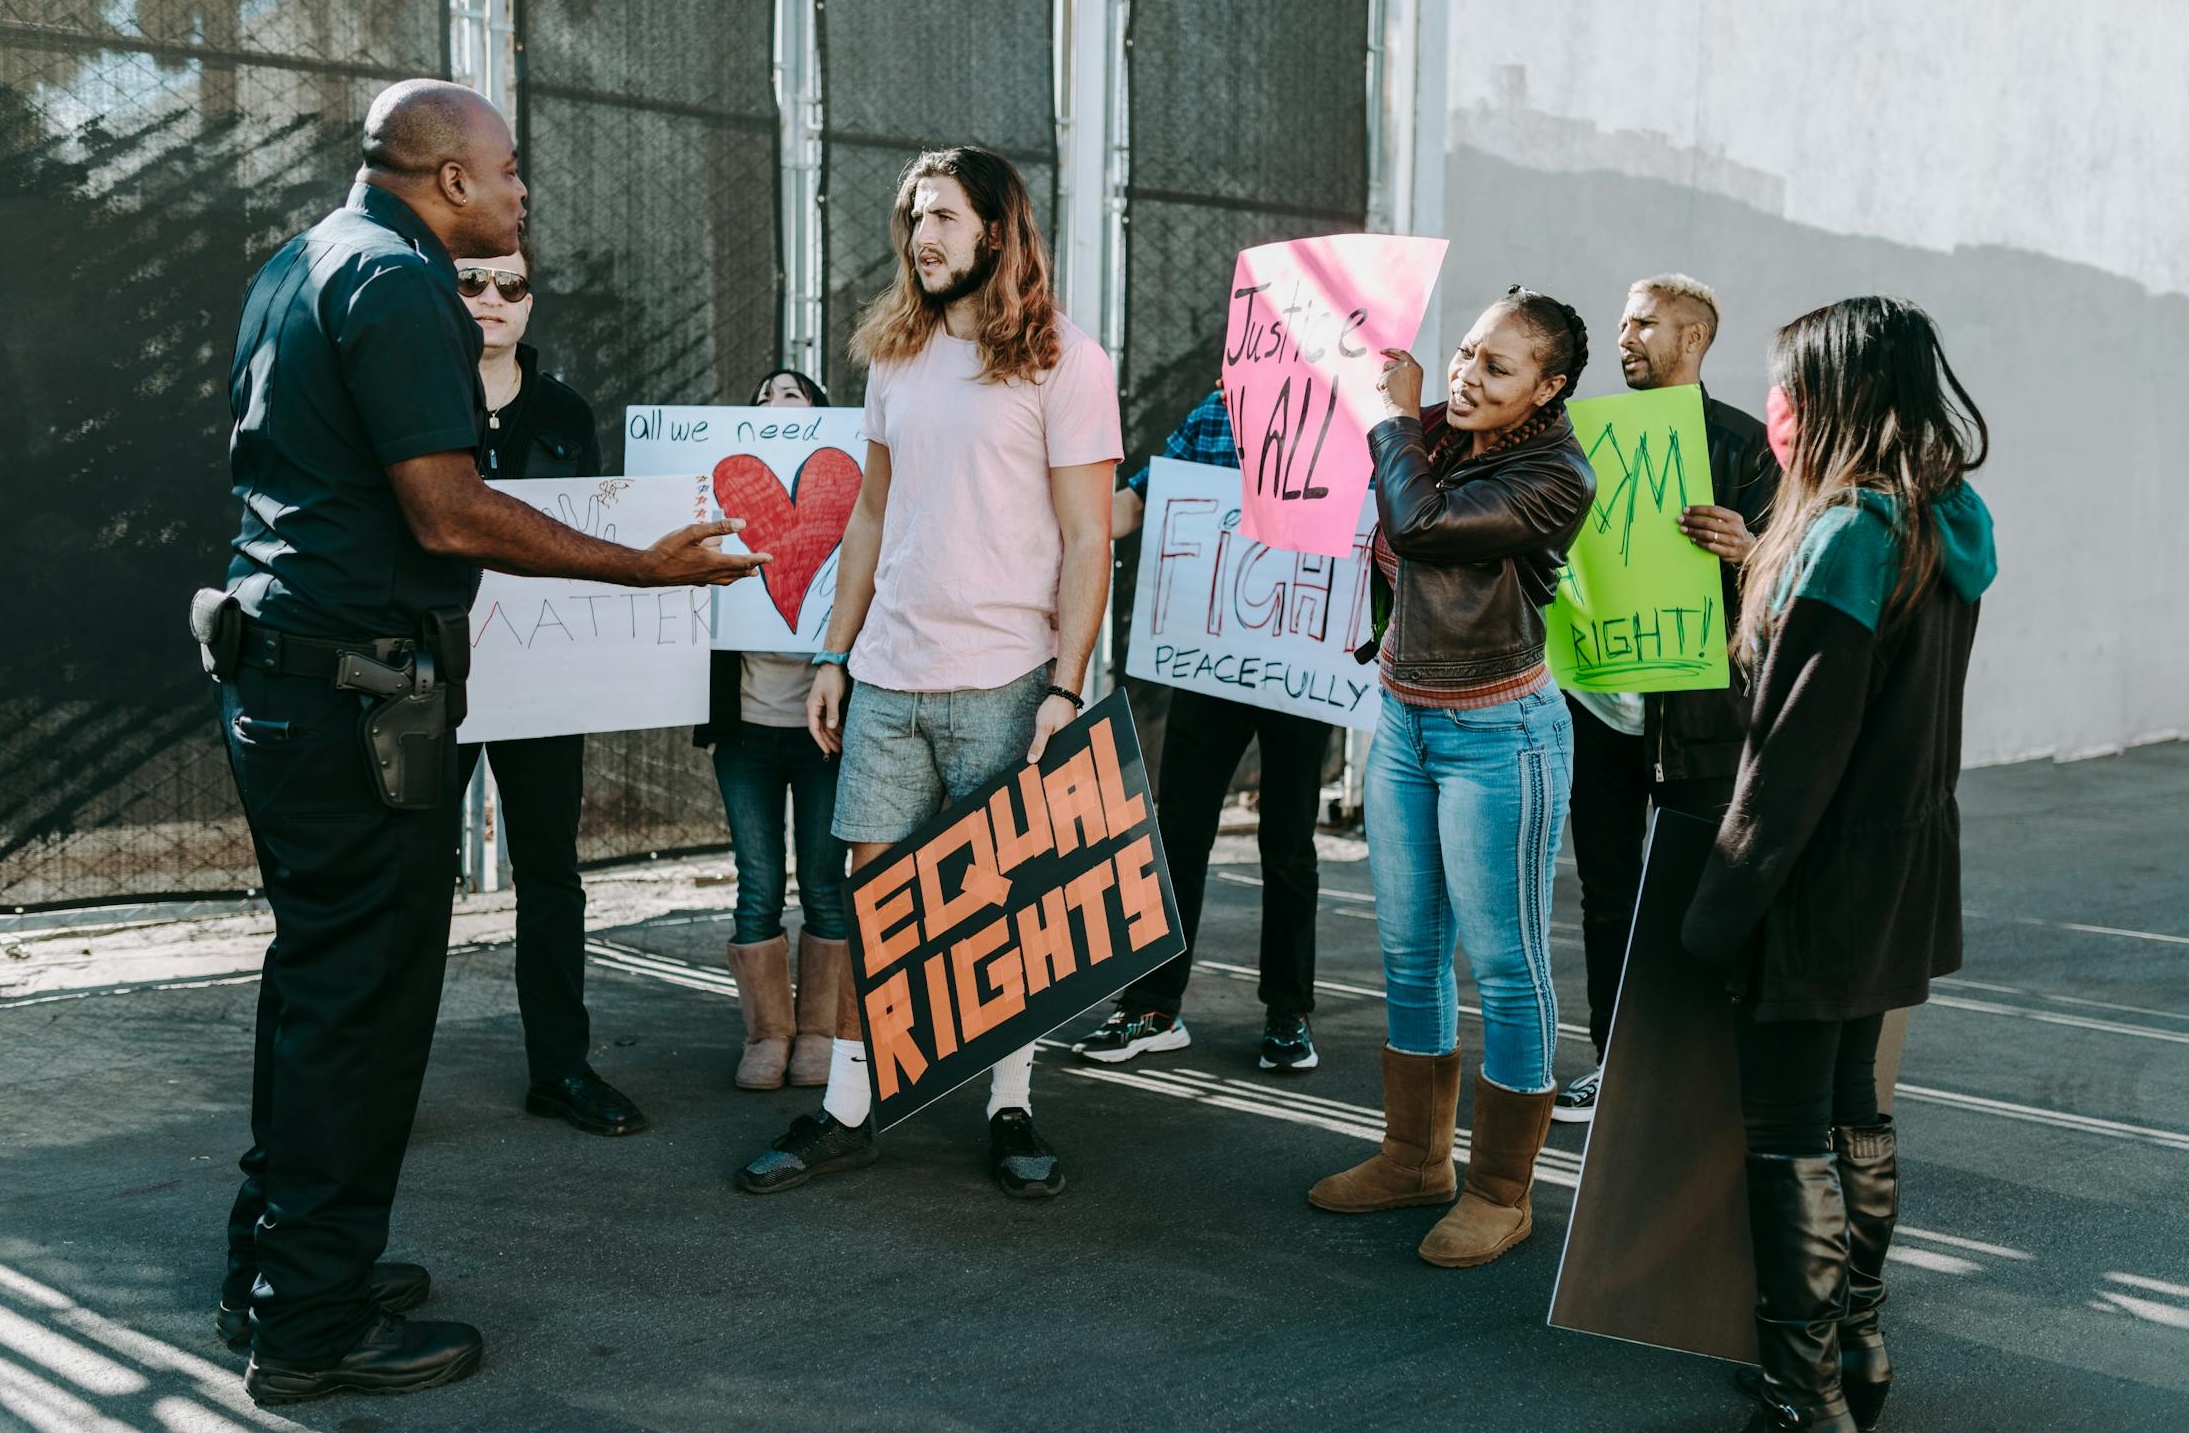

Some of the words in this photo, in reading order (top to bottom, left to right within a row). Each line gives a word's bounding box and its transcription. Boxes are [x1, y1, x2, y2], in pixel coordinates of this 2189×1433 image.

[1227, 279, 1368, 366] Justice
[630, 409, 662, 441] all
[670, 419, 709, 443] we
[737, 416, 822, 442] need
[1257, 375, 1340, 500] ALL
[1570, 595, 1713, 672] RIGHT!
[1155, 645, 1371, 711] PEACEFULLY
[853, 717, 1147, 979] EQUAL
[865, 834, 1170, 1101] RIGHTS
